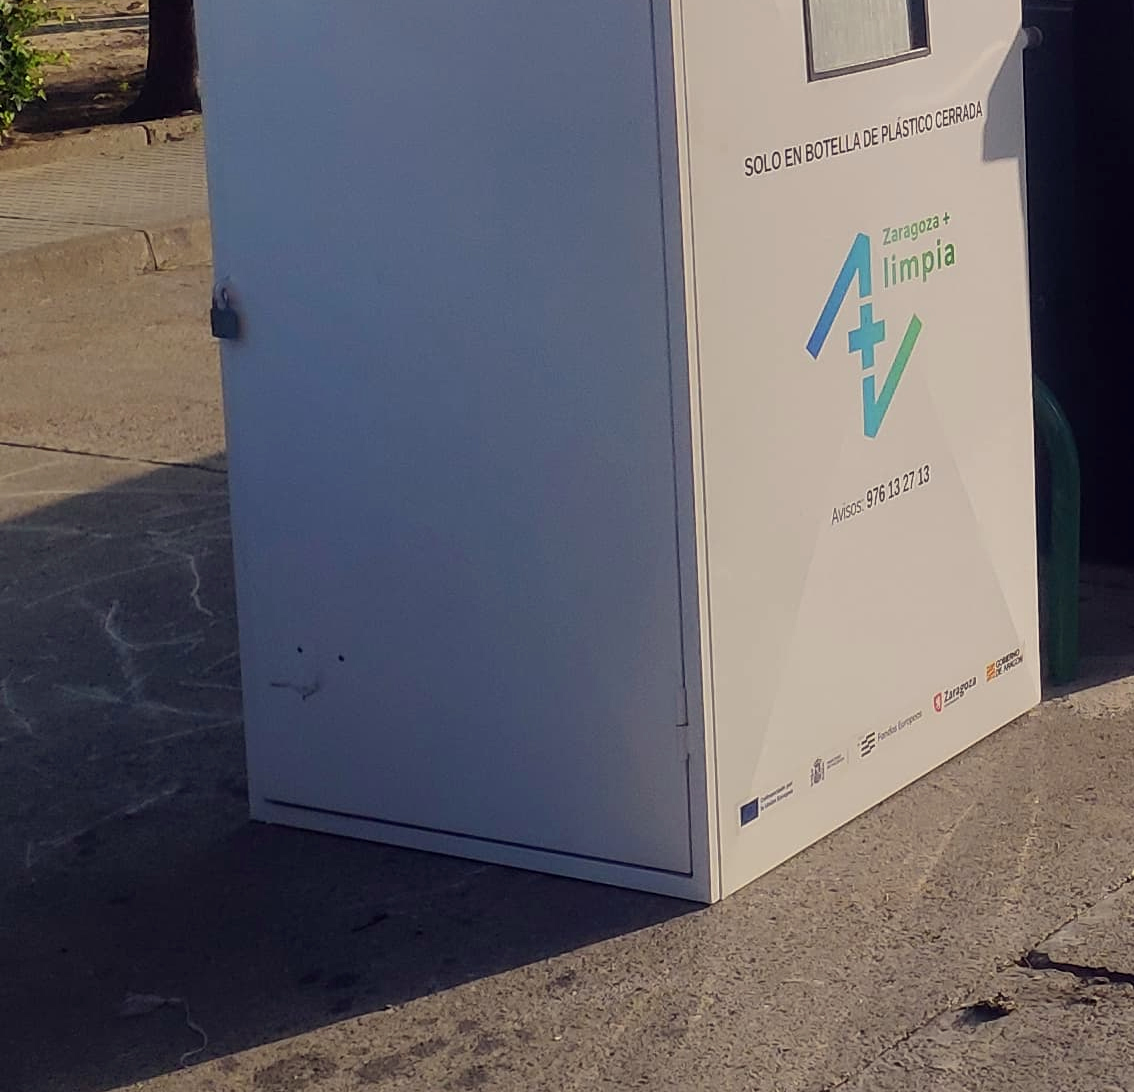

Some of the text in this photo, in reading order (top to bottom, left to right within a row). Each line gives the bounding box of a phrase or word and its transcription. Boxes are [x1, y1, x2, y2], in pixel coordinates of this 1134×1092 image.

[744, 101, 983, 177] SOLO EN BOTELLA DE PLÁSTICO CERRADA
[883, 215, 940, 245] Zaragoza
[883, 238, 955, 288] limpia
[831, 464, 930, 525] Avisos: 976 13 27 13
[943, 676, 977, 703] Zaragoza
